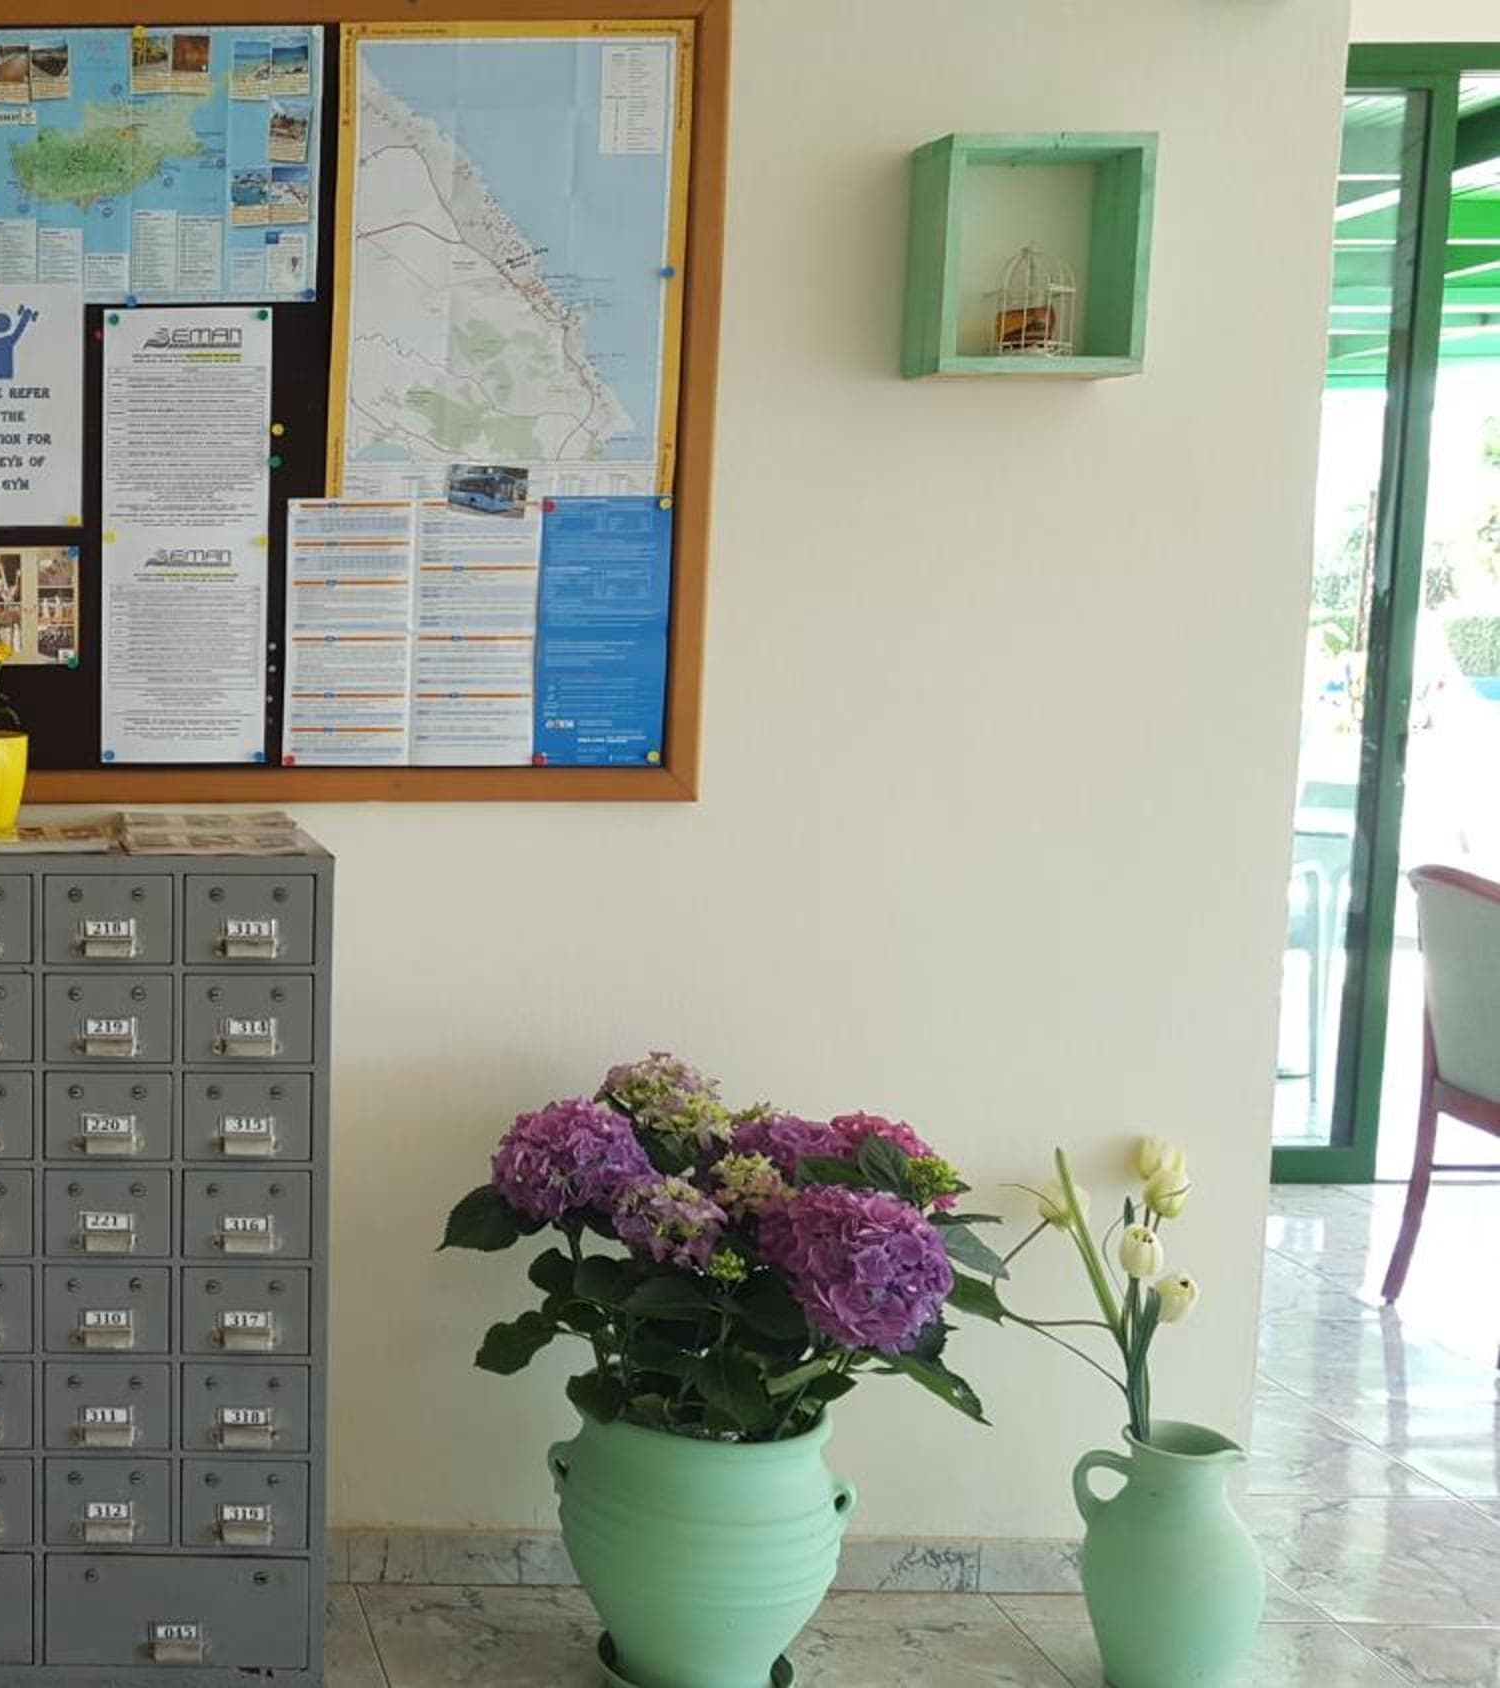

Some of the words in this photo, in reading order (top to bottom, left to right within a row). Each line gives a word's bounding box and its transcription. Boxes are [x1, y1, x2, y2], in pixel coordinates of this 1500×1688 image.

[9, 388, 50, 399] REFER
[1, 411, 25, 422] THE
[27, 434, 52, 445] FOR
[29, 457, 45, 468] OF
[2, 480, 29, 491] GYM
[94, 1021, 122, 1033] 219
[92, 1118, 120, 1131] 220
